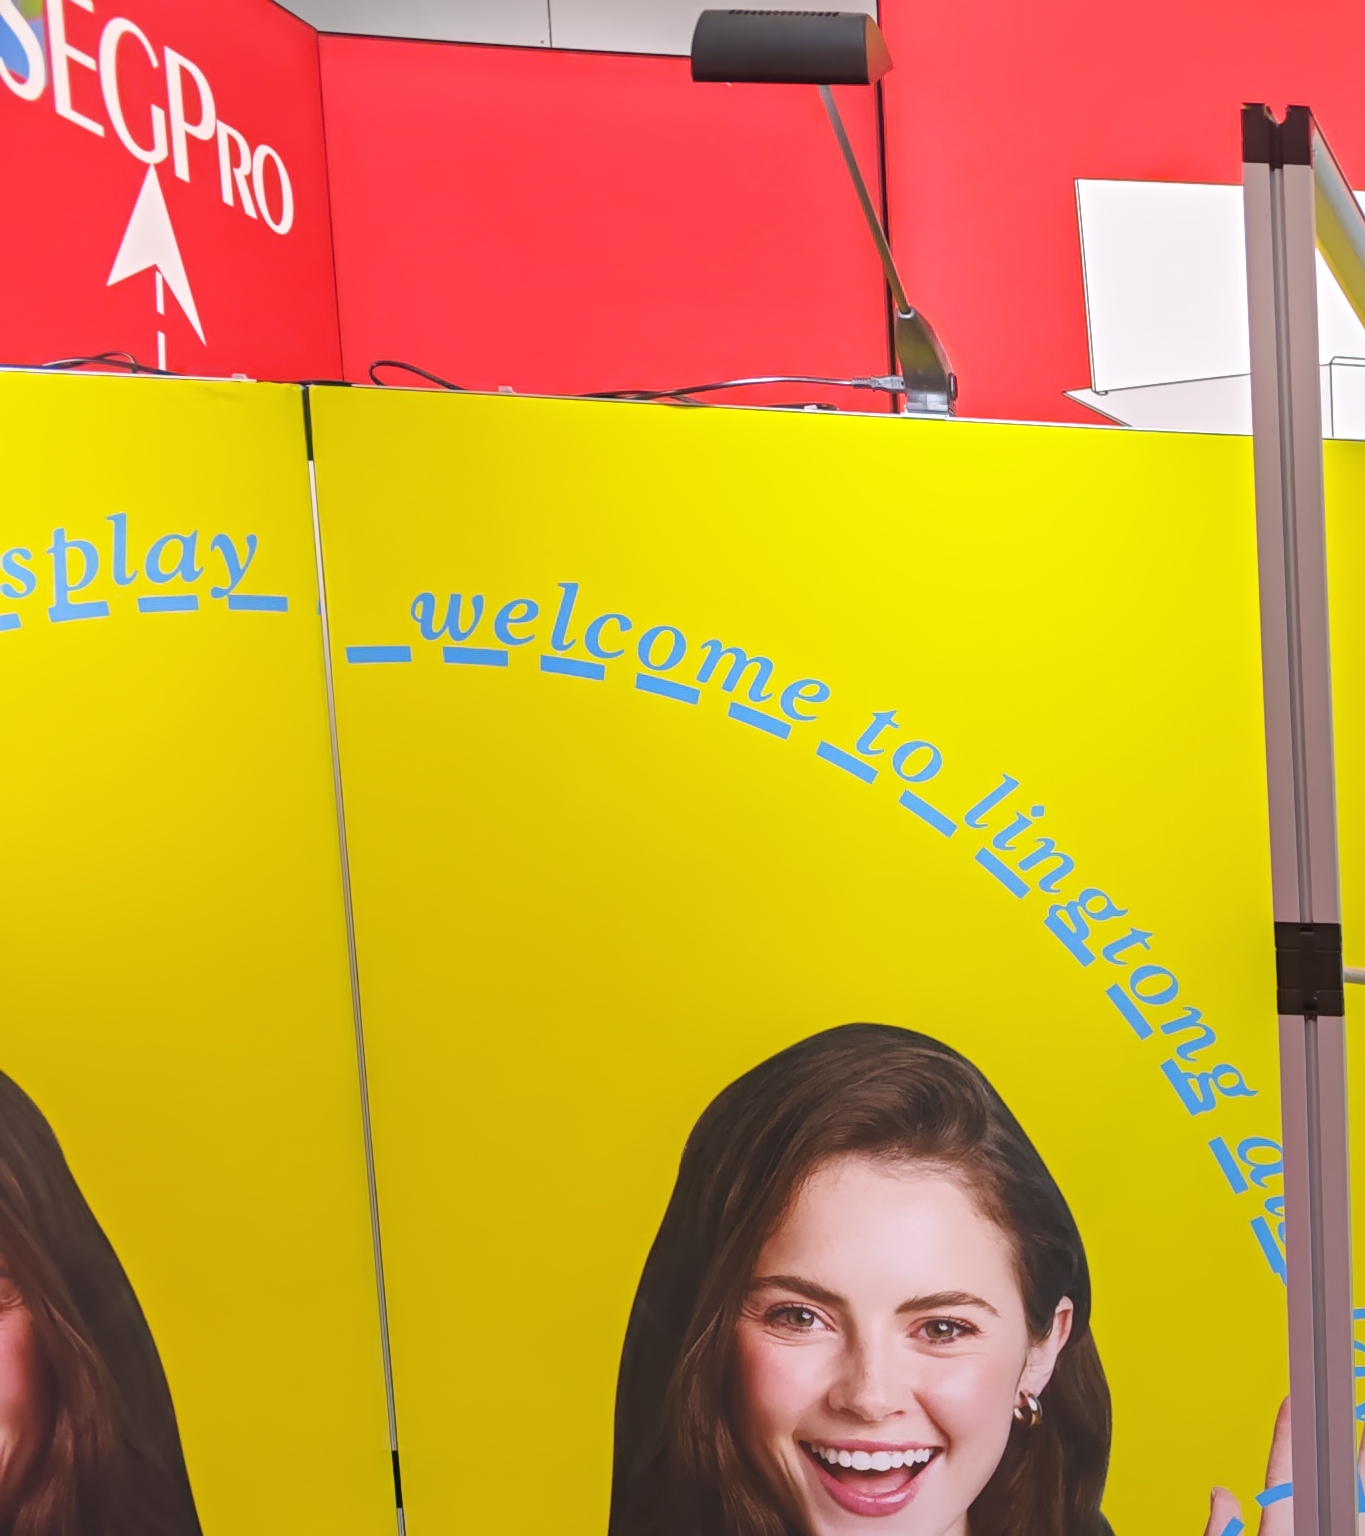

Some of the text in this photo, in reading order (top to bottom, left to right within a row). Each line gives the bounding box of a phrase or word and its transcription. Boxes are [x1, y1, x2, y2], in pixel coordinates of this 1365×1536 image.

[410, 583, 831, 723] welcome
[855, 709, 942, 783] to
[964, 774, 1259, 1115] lingtong
